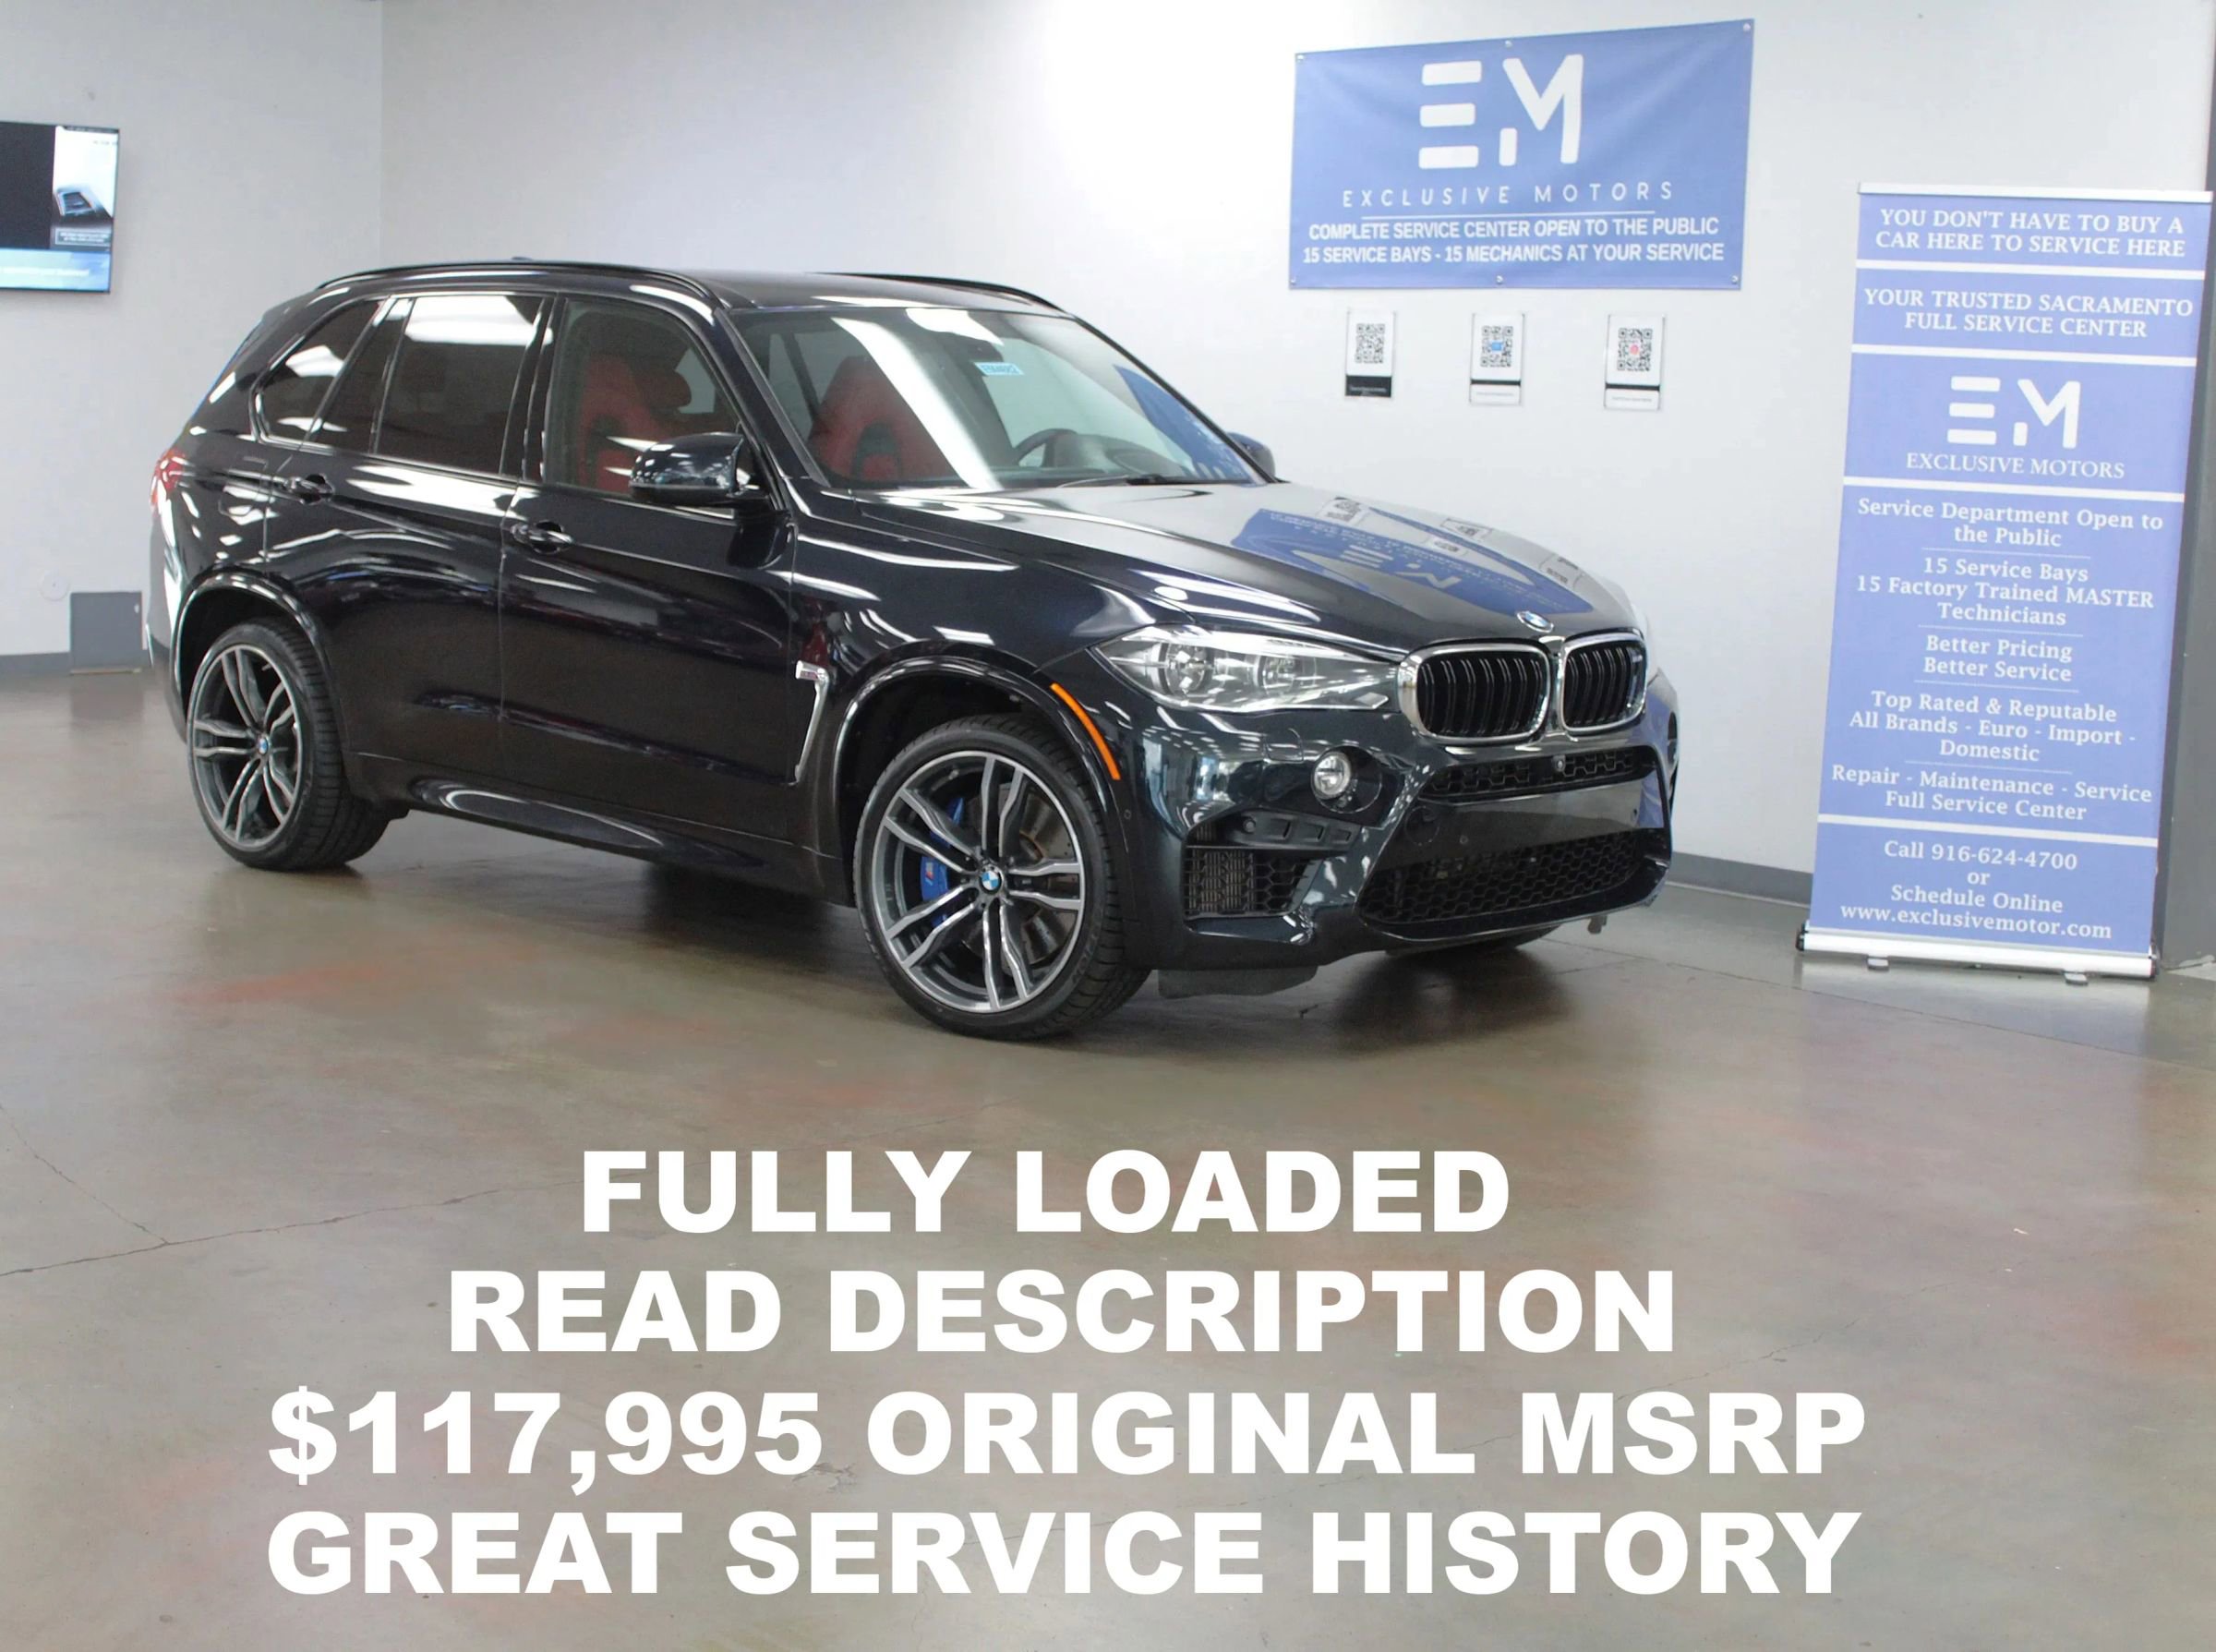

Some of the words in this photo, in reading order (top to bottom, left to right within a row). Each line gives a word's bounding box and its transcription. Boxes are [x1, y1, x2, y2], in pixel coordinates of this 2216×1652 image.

[1343, 186, 1509, 207] EXCLUSIVE
[1536, 182, 1671, 202] MOTORS
[1309, 223, 1389, 239] COMPLETE
[1393, 222, 1460, 238] SERVICE
[1464, 221, 1530, 237] CENTER
[1535, 220, 1581, 236] OPEN
[1584, 219, 1608, 235] TO
[1613, 218, 1647, 235] THE
[1654, 217, 1718, 235] PUBLIC
[1881, 210, 1926, 225] YOU
[1934, 211, 2003, 228] DON'T
[2010, 212, 2070, 230] HAVE
[2078, 214, 2110, 231] TO
[2117, 216, 2161, 233] BUY
[2168, 218, 2183, 234] A
[1304, 247, 1319, 262] 15
[1323, 247, 1387, 262] SERVICE
[1391, 246, 1431, 262] BAYS
[1445, 246, 1463, 261] 15
[1466, 245, 1562, 262] MECHANICS
[1567, 244, 1588, 260] AT
[1594, 244, 1642, 260] YOUR
[1646, 243, 1724, 260] SERVICE
[1876, 232, 1919, 247] CAR
[1928, 233, 1983, 249] HERE
[1992, 235, 2022, 251] TO
[2029, 235, 2120, 254] SERVICE
[2127, 239, 2185, 256] HERE
[1865, 289, 1923, 306] YOUR
[1932, 291, 2031, 309] TRUSTED
[2039, 295, 2193, 316] SACRAMENTO
[1906, 312, 1957, 330] FULL
[1964, 314, 2053, 333] SERVICE
[2061, 318, 2146, 337] CENTER
[1908, 453, 2023, 473] EXCLUSIVE
[2031, 459, 2124, 478] MOTORS
[1859, 498, 1933, 517] Service
[1942, 502, 2068, 527] Department
[2078, 510, 2133, 530] Open
[2142, 514, 2162, 529] to
[1955, 525, 1987, 542] the
[1995, 528, 2061, 547] Public
[1925, 558, 1947, 573] 15
[1956, 559, 2031, 578] Service
[2041, 563, 2088, 584] Bays
[1859, 575, 1880, 592] 15
[1889, 577, 1968, 600] Factory
[1975, 583, 2057, 602] Trained
[2066, 587, 2153, 608] MASTER
[1938, 603, 2065, 625] Technicians
[1927, 635, 1990, 654] Better
[1997, 639, 2073, 663] Pricing
[1924, 657, 1988, 676] Better
[1994, 661, 2071, 681] Service
[1872, 691, 1911, 711] Top
[1920, 694, 1979, 713] Rated
[1986, 698, 2002, 714] &
[2009, 700, 2116, 722] Reputable
[1850, 711, 1878, 728] All
[1886, 714, 1957, 733] Brands
[1979, 720, 2028, 738] Euro
[2049, 725, 2122, 745] Import
[1941, 740, 2039, 761] Domestic
[1833, 765, 1899, 785] Repair
[1920, 772, 2053, 795] Maintenance
[2076, 782, 2151, 802] Service
[1886, 790, 1924, 808] Full
[1933, 794, 2007, 814] Service
[2016, 800, 2087, 819] Center
[1885, 841, 1923, 858] Call
[1933, 844, 2078, 870] 916-624-4700
[1968, 872, 1991, 885] or
[1892, 885, 1985, 907] Schedule
[1993, 893, 2063, 912] Online
[1840, 904, 2112, 939] www.exclusivemotor.com
